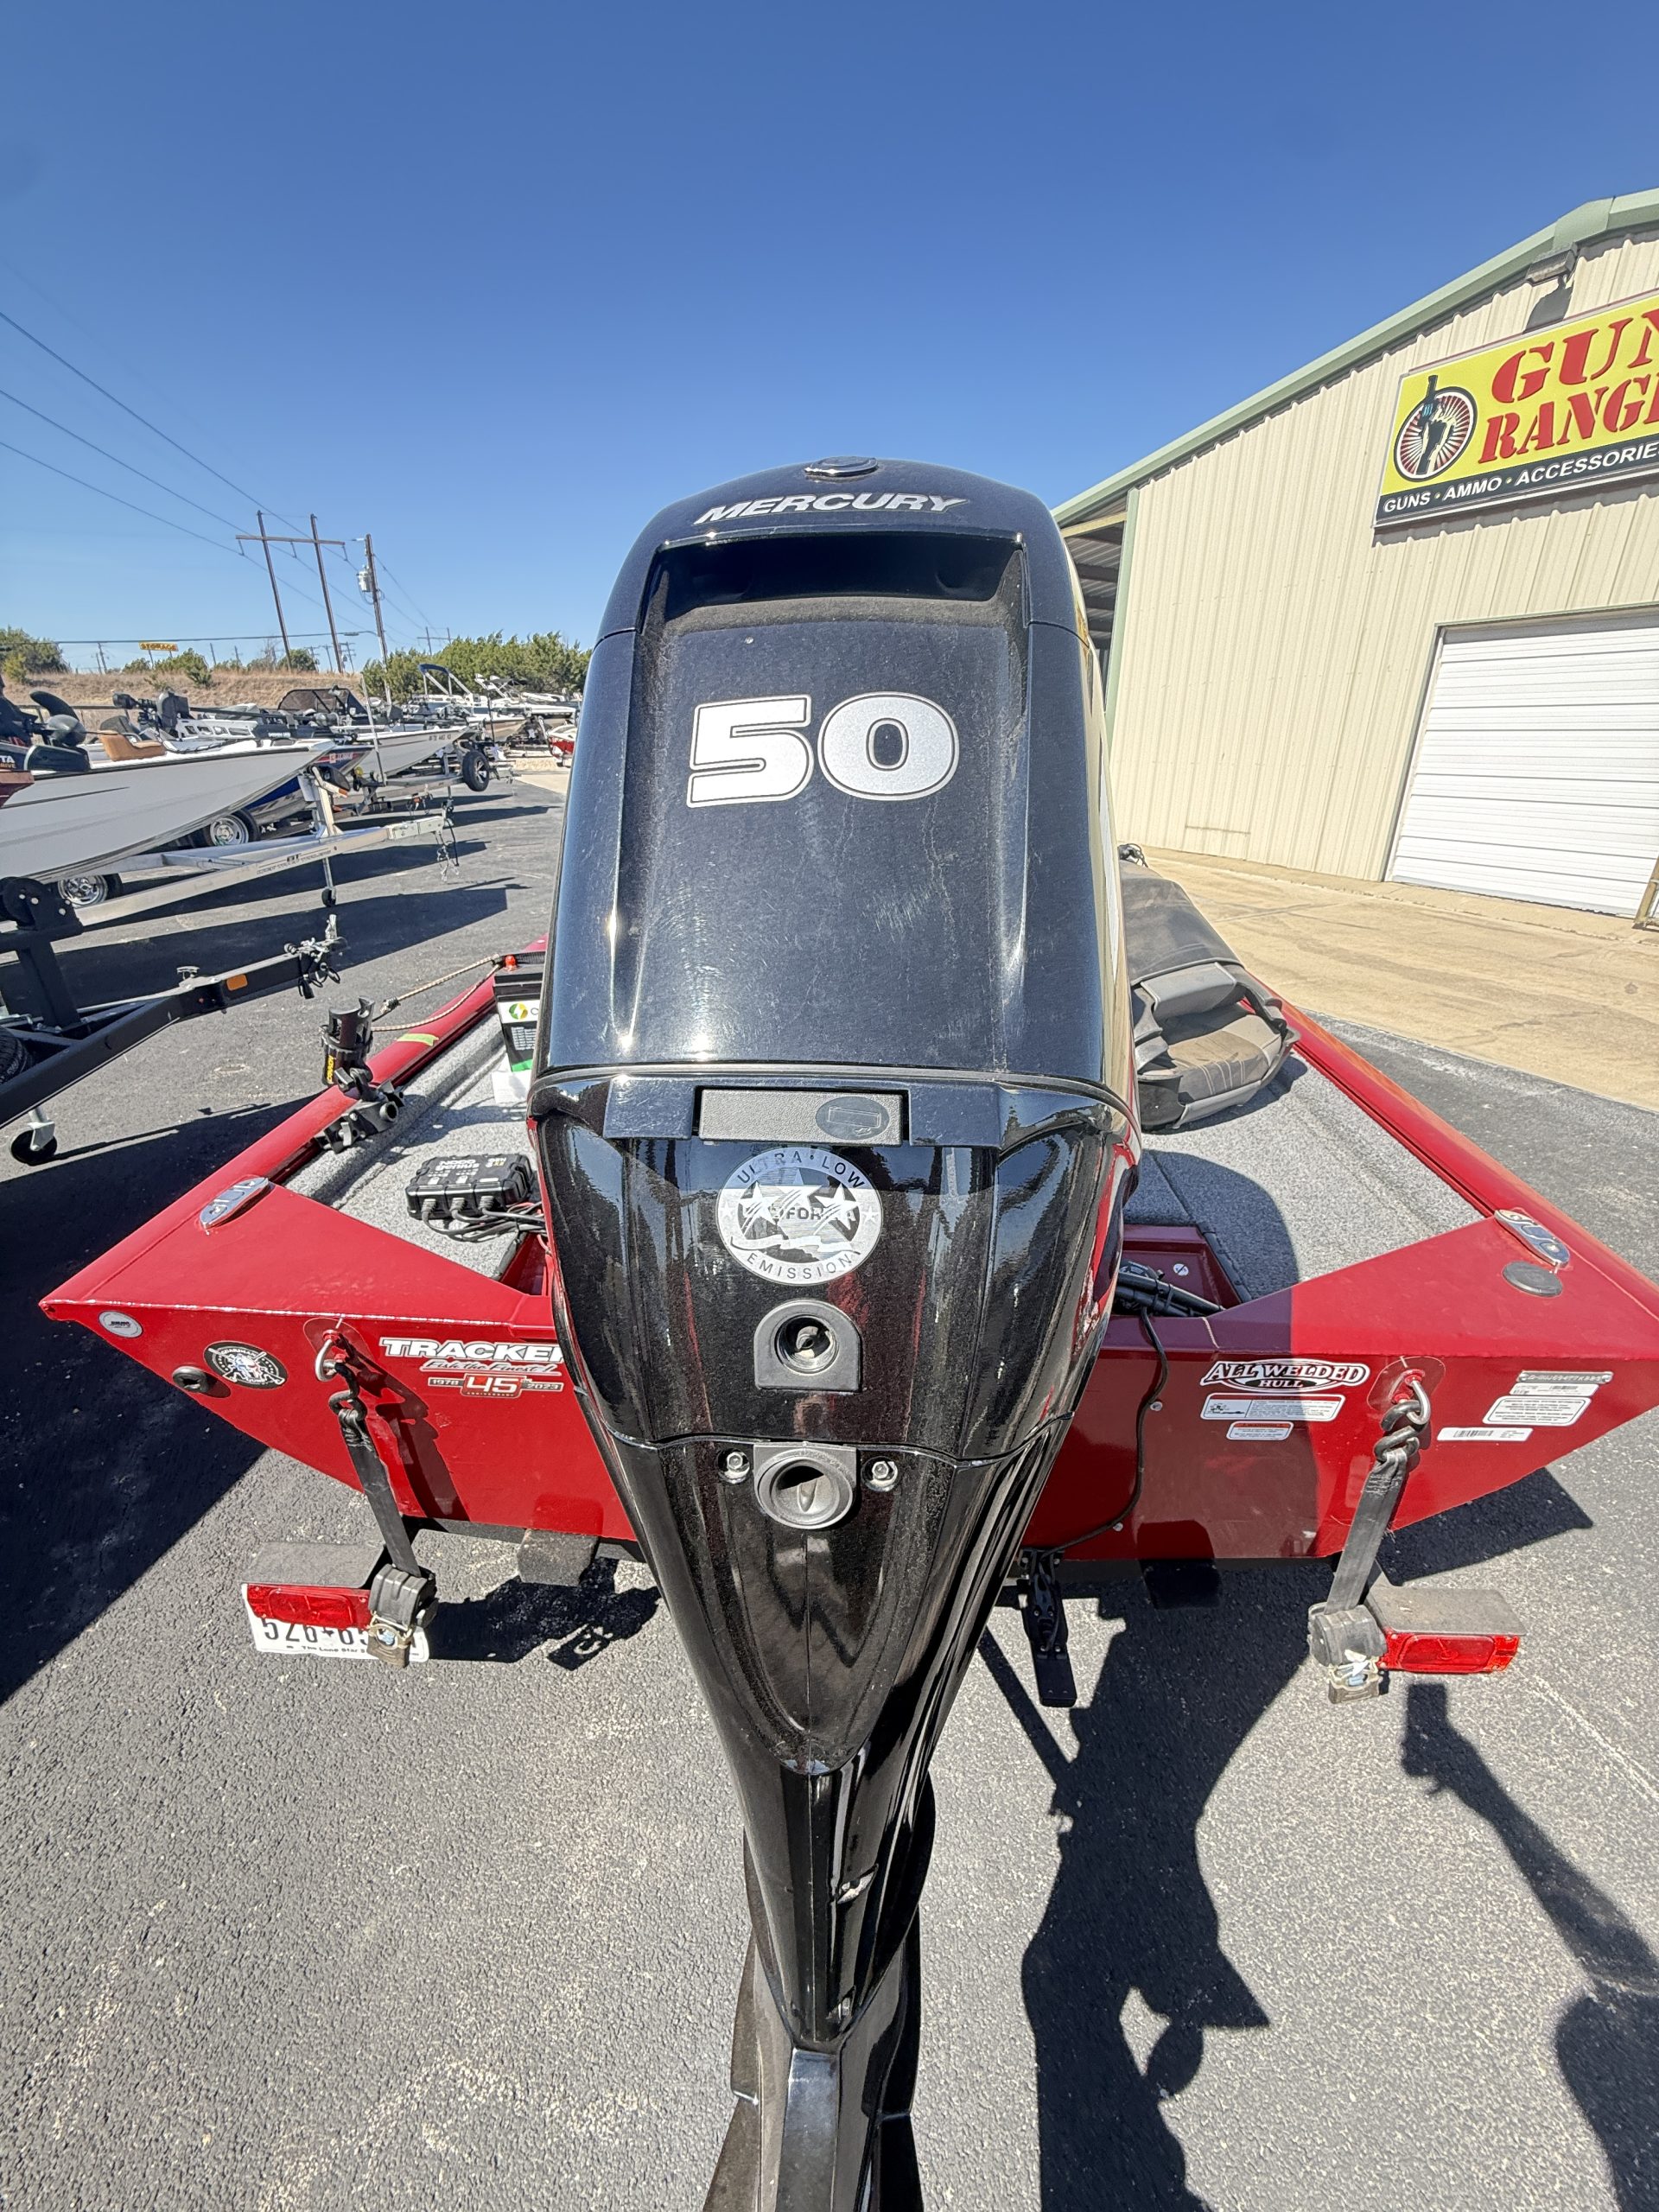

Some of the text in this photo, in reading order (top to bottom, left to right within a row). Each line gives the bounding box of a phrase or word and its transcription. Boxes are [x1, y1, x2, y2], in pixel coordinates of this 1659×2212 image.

[1384, 441, 1659, 513] GUNS AMMO ACCESSORIE
[694, 493, 969, 524] MERCURY
[686, 692, 959, 808] 50
[737, 1150, 865, 1189] ULTRA LOW
[747, 1253, 853, 1280] EMISSION
[427, 1359, 459, 1369] Fish
[462, 1361, 486, 1370] the
[1205, 1363, 1367, 1382] ALL WELDED
[466, 1376, 518, 1393] 45
[1258, 1379, 1304, 1388] HULL
